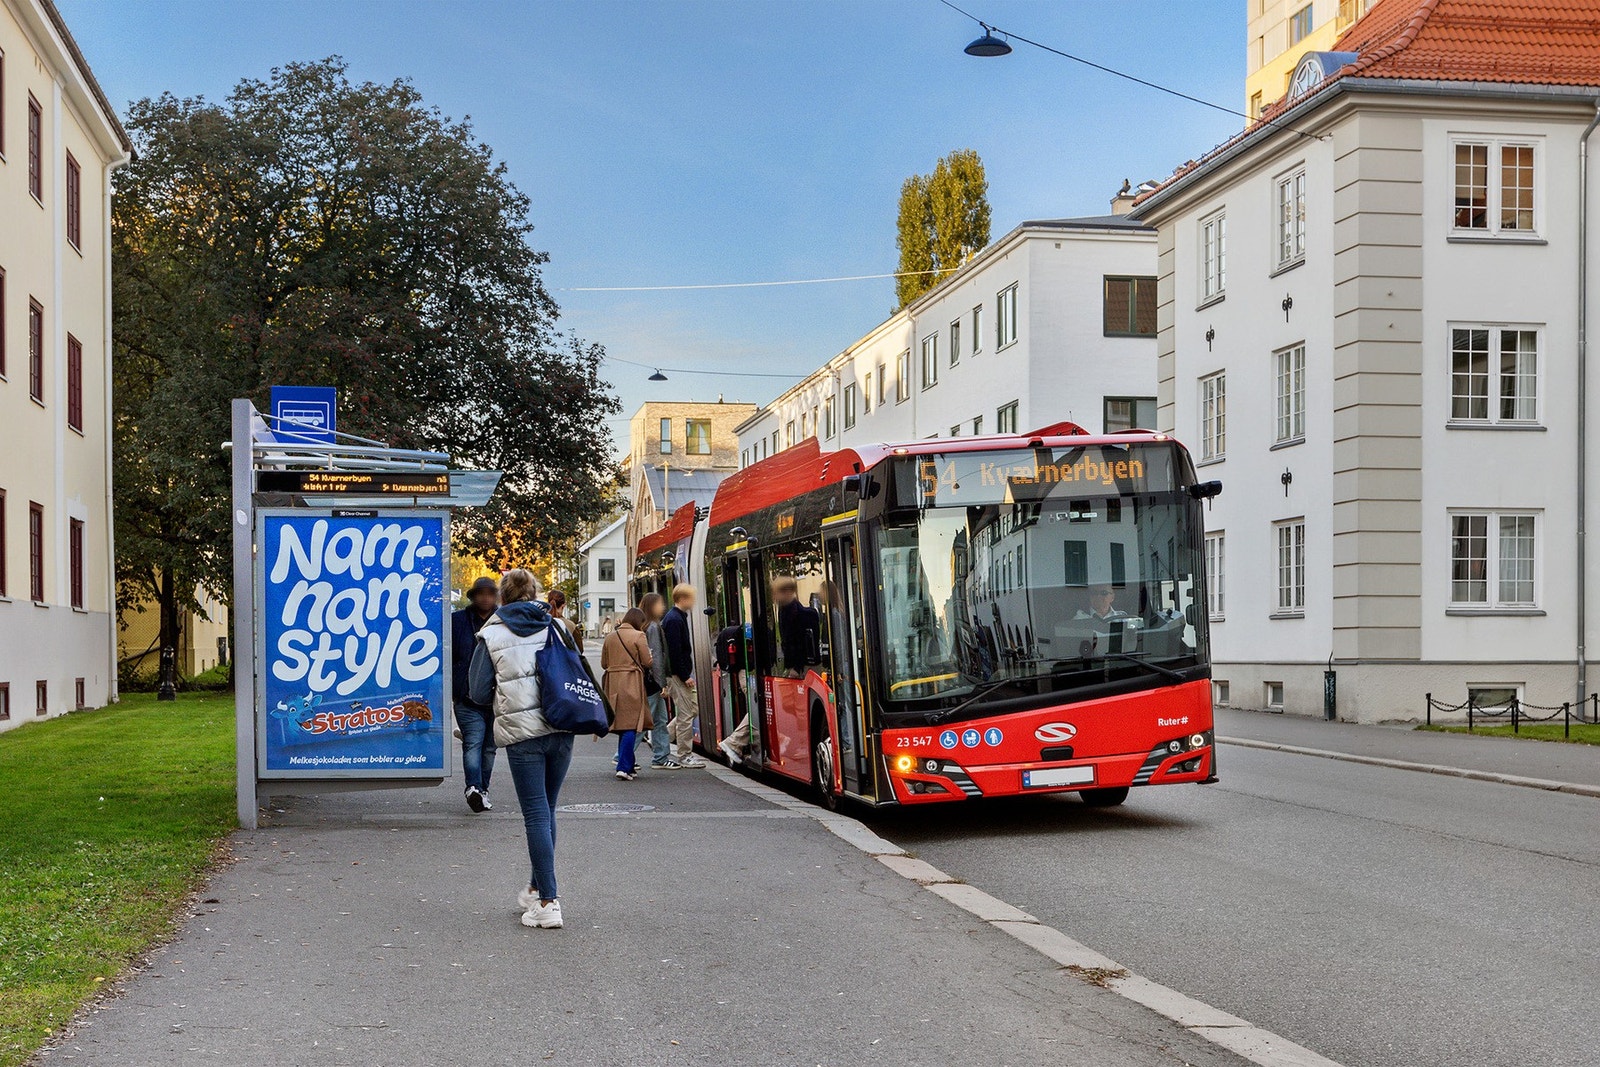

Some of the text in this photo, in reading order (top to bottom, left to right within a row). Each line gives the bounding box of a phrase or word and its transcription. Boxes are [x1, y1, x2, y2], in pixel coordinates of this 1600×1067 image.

[309, 473, 320, 482] 54
[919, 455, 1144, 497] 54 Kværnerbyen
[270, 519, 437, 584] Nam-
[281, 572, 428, 638] nam
[310, 704, 405, 735] Stratos
[1157, 716, 1189, 727] Ruter#
[896, 735, 933, 748] 23 547
[289, 755, 352, 766] Melkesjokoladen
[352, 756, 369, 764] som
[370, 754, 394, 764] bobler
[404, 754, 427, 765] glede
